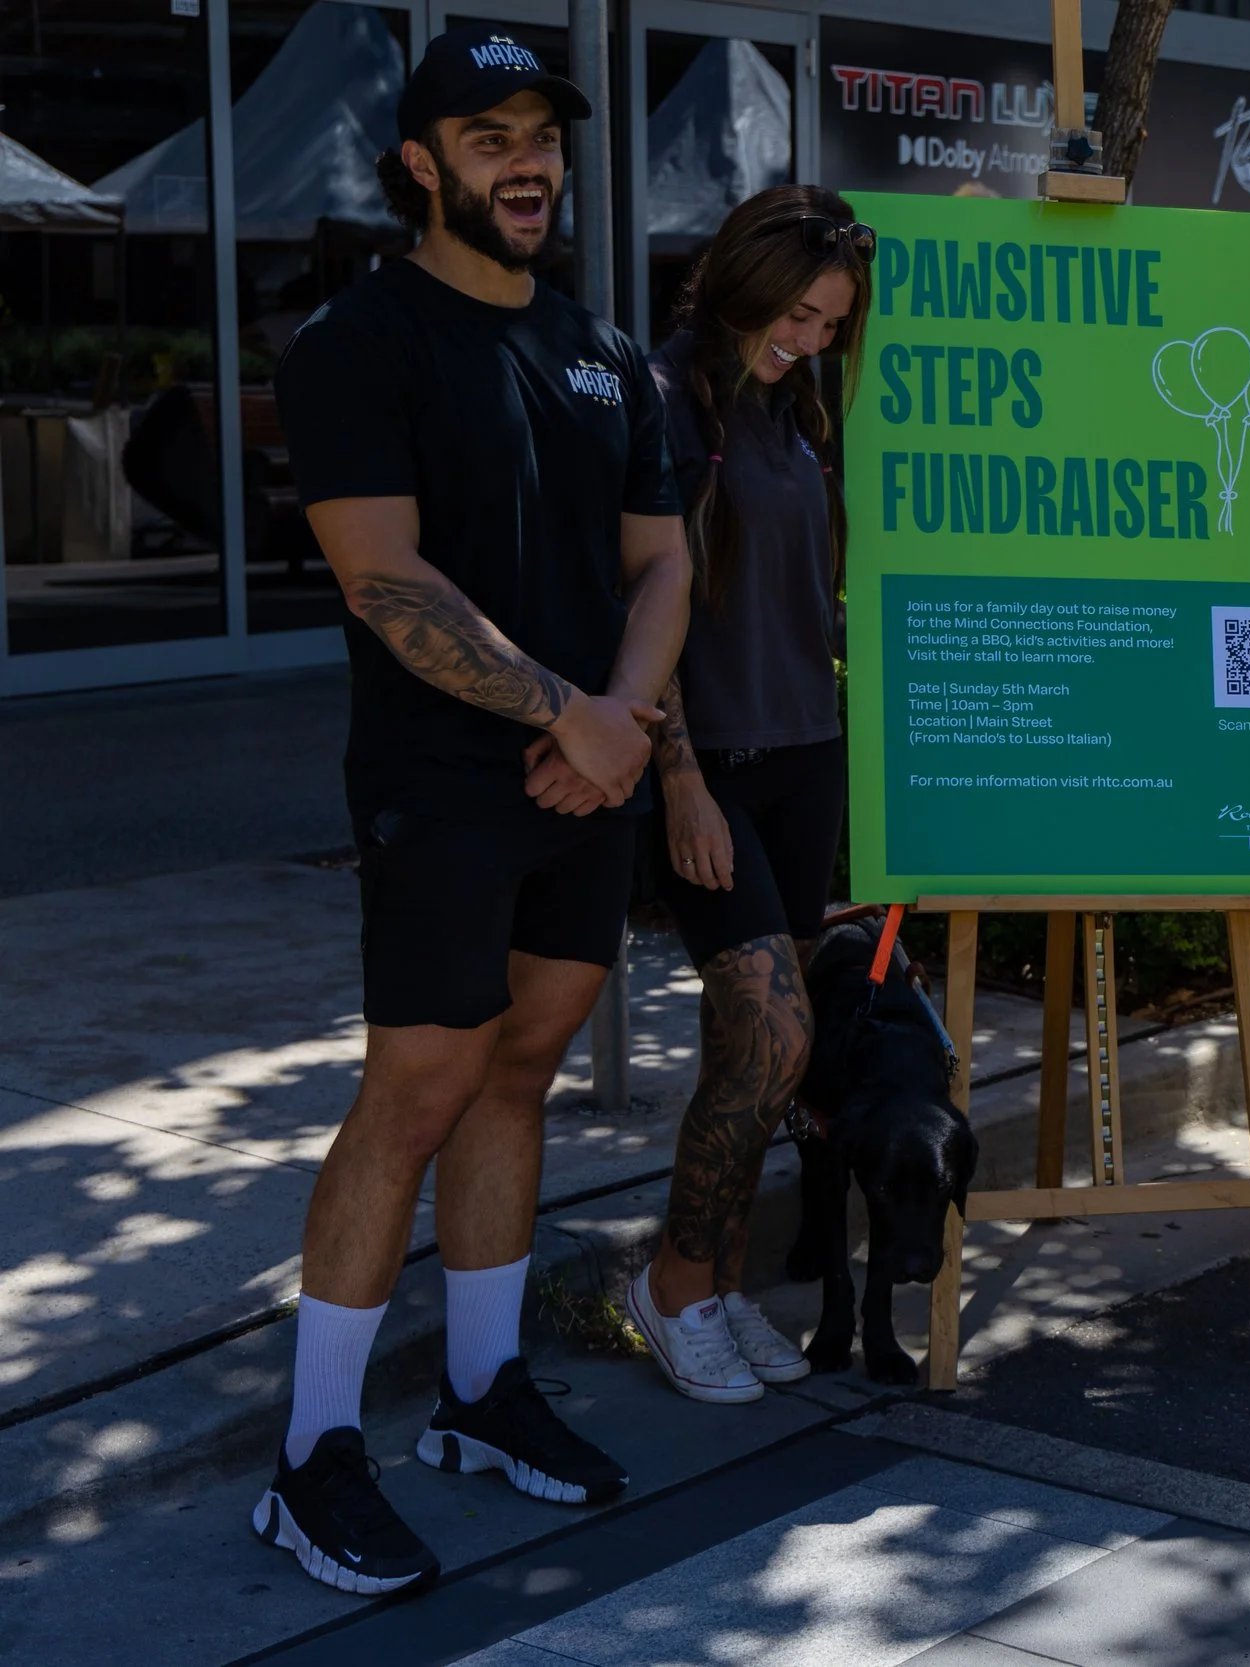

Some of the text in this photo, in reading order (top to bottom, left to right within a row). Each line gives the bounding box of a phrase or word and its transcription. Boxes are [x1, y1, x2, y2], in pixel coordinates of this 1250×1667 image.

[470, 44, 539, 70] MAXFIT
[831, 64, 984, 123] TITAN
[927, 136, 985, 178] Dolby
[878, 237, 1163, 327] PAWSITIVE
[566, 367, 622, 402] MAXFIT
[879, 343, 1043, 429] STEPS
[882, 451, 1210, 540] FUNDRAISER
[906, 600, 1177, 619] Join us for a family day out to raise money
[907, 616, 1153, 634] for the Mind Connections Foundation,
[907, 633, 969, 648] including
[971, 636, 979, 645] a
[982, 634, 1012, 648] BBQ,
[1047, 635, 1107, 648] activities
[1109, 637, 1133, 648] and
[1136, 638, 1175, 649] more!
[907, 650, 1095, 663] Visit their stall to learn more.
[908, 682, 940, 694] Date
[949, 682, 999, 697] Sunday
[1002, 683, 1025, 695] 5th
[1028, 684, 1070, 695] March
[908, 698, 942, 711] Time
[951, 699, 989, 711] 10am
[1002, 700, 1034, 713] 3pm
[909, 715, 967, 727] Location
[976, 715, 1009, 728] Main
[1011, 716, 1053, 728] Street
[909, 730, 950, 746] (From
[1009, 733, 1023, 744] to
[1026, 733, 1064, 744] Lusso
[1067, 732, 1112, 747] Italian)
[910, 774, 1173, 788] For more information visit rhtc.com.au
